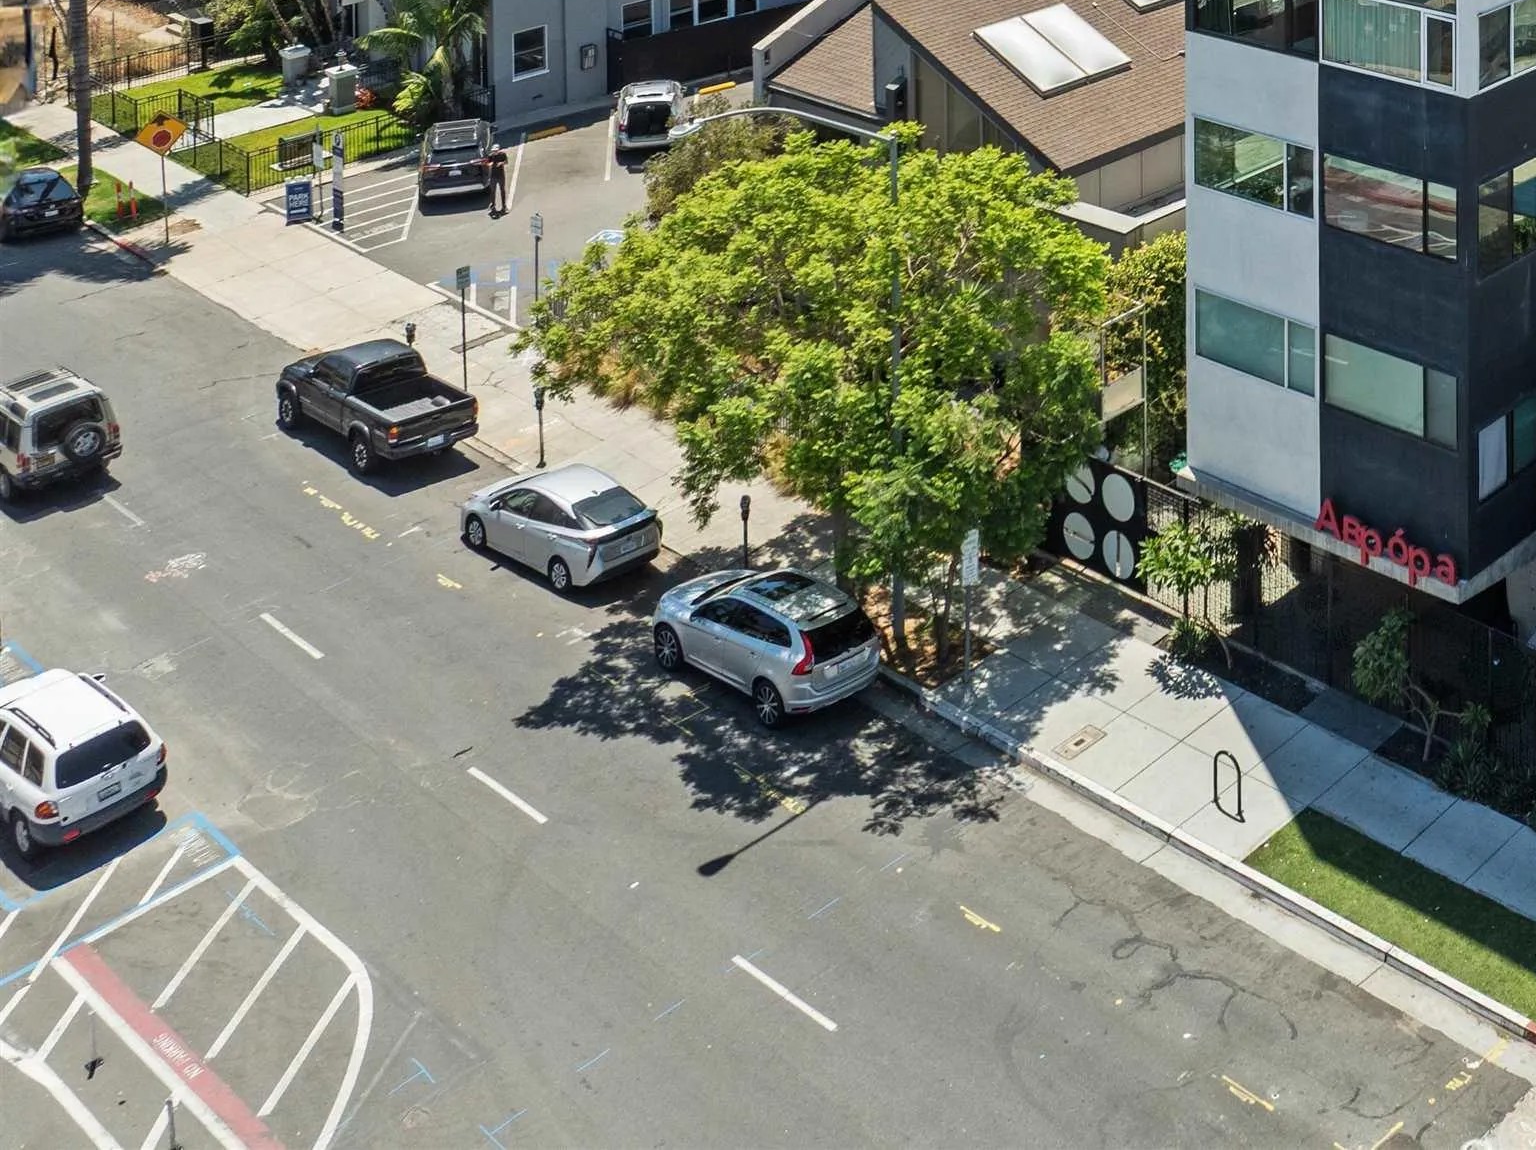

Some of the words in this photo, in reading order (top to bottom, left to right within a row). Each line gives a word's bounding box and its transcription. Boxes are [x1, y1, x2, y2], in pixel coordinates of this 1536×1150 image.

[288, 193, 309, 202] PARK
[152, 1033, 191, 1065] PARKING
[184, 1063, 205, 1079] NO
